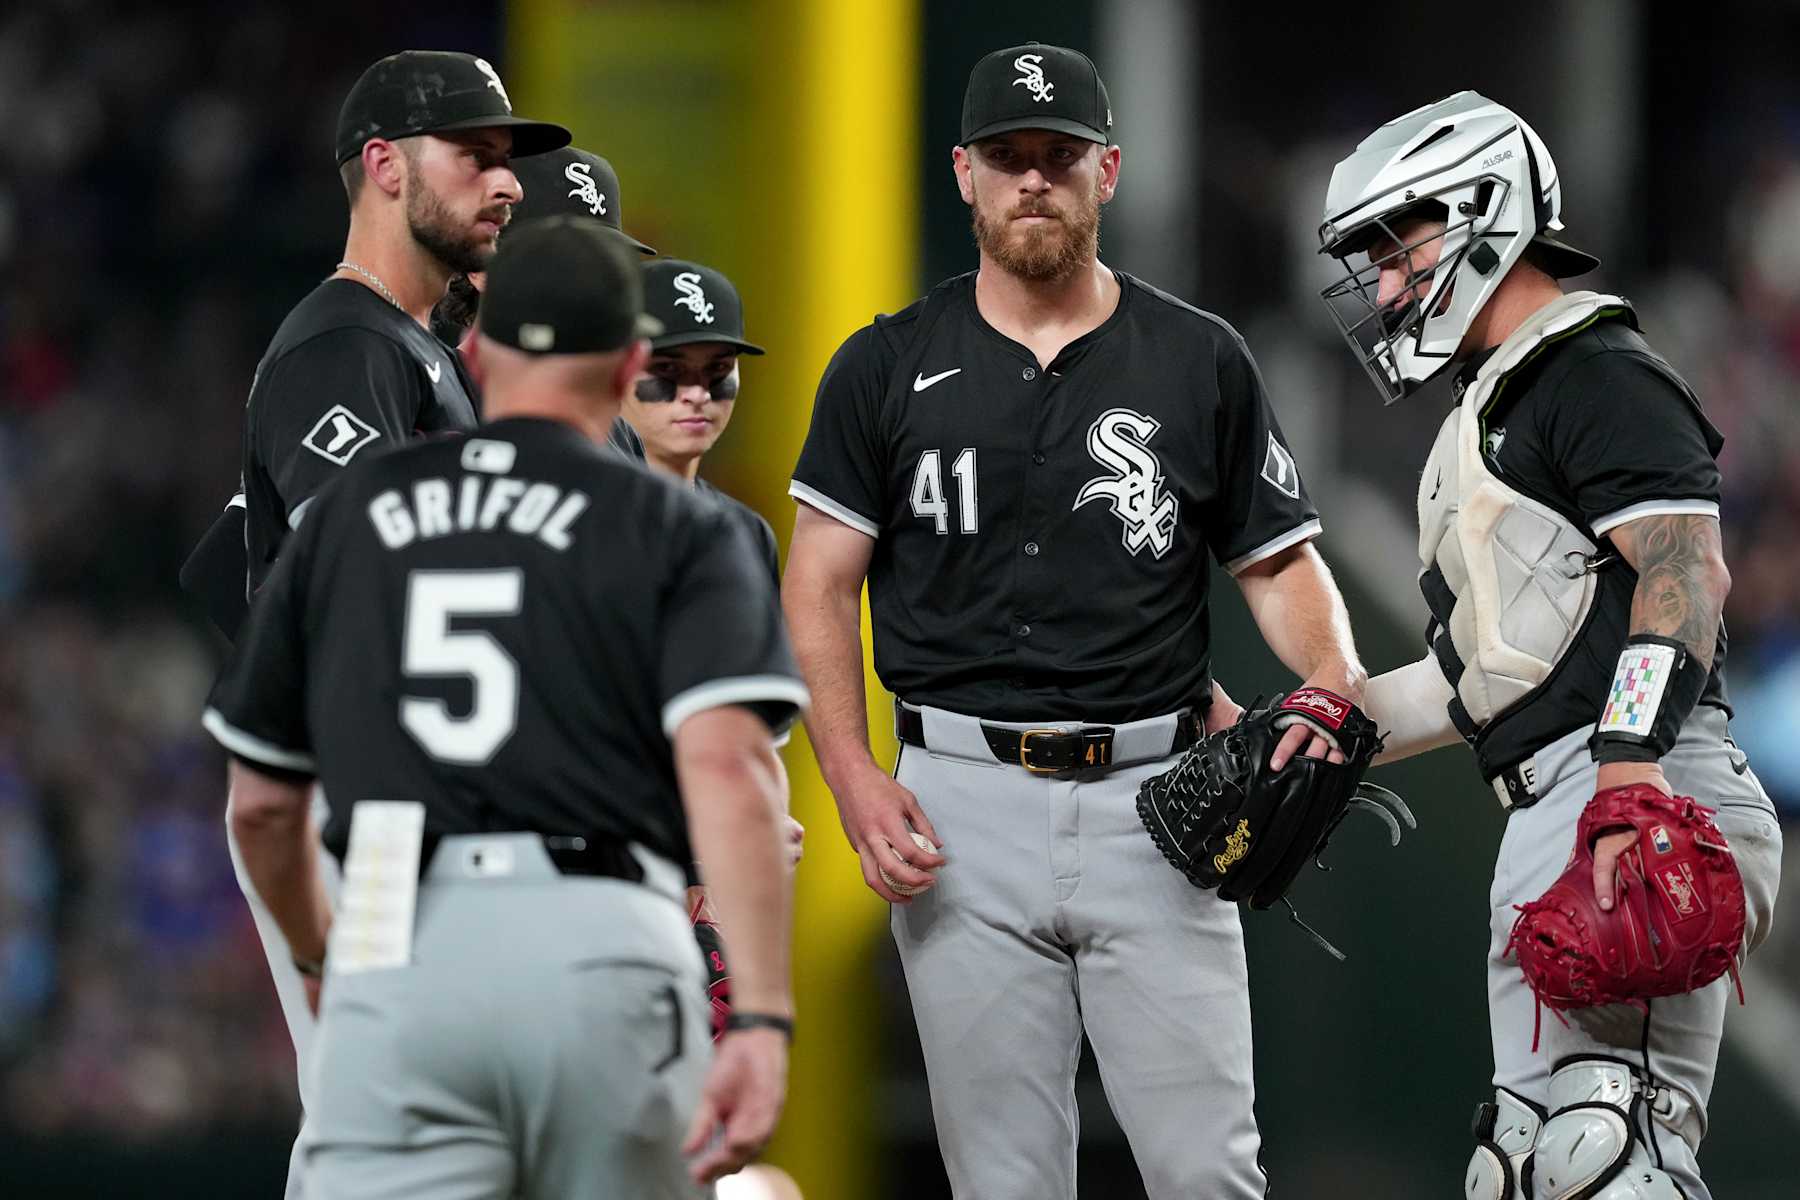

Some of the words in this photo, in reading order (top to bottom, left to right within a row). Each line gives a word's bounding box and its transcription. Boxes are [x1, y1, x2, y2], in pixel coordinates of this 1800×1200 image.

[1012, 54, 1054, 102] Sox
[565, 162, 606, 215] Sox
[673, 272, 714, 324] Sox
[368, 474, 589, 551] GRIFOL
[909, 447, 978, 535] 41
[1072, 407, 1179, 560] Sox
[399, 566, 524, 767] 5
[1085, 743, 1106, 766] 41
